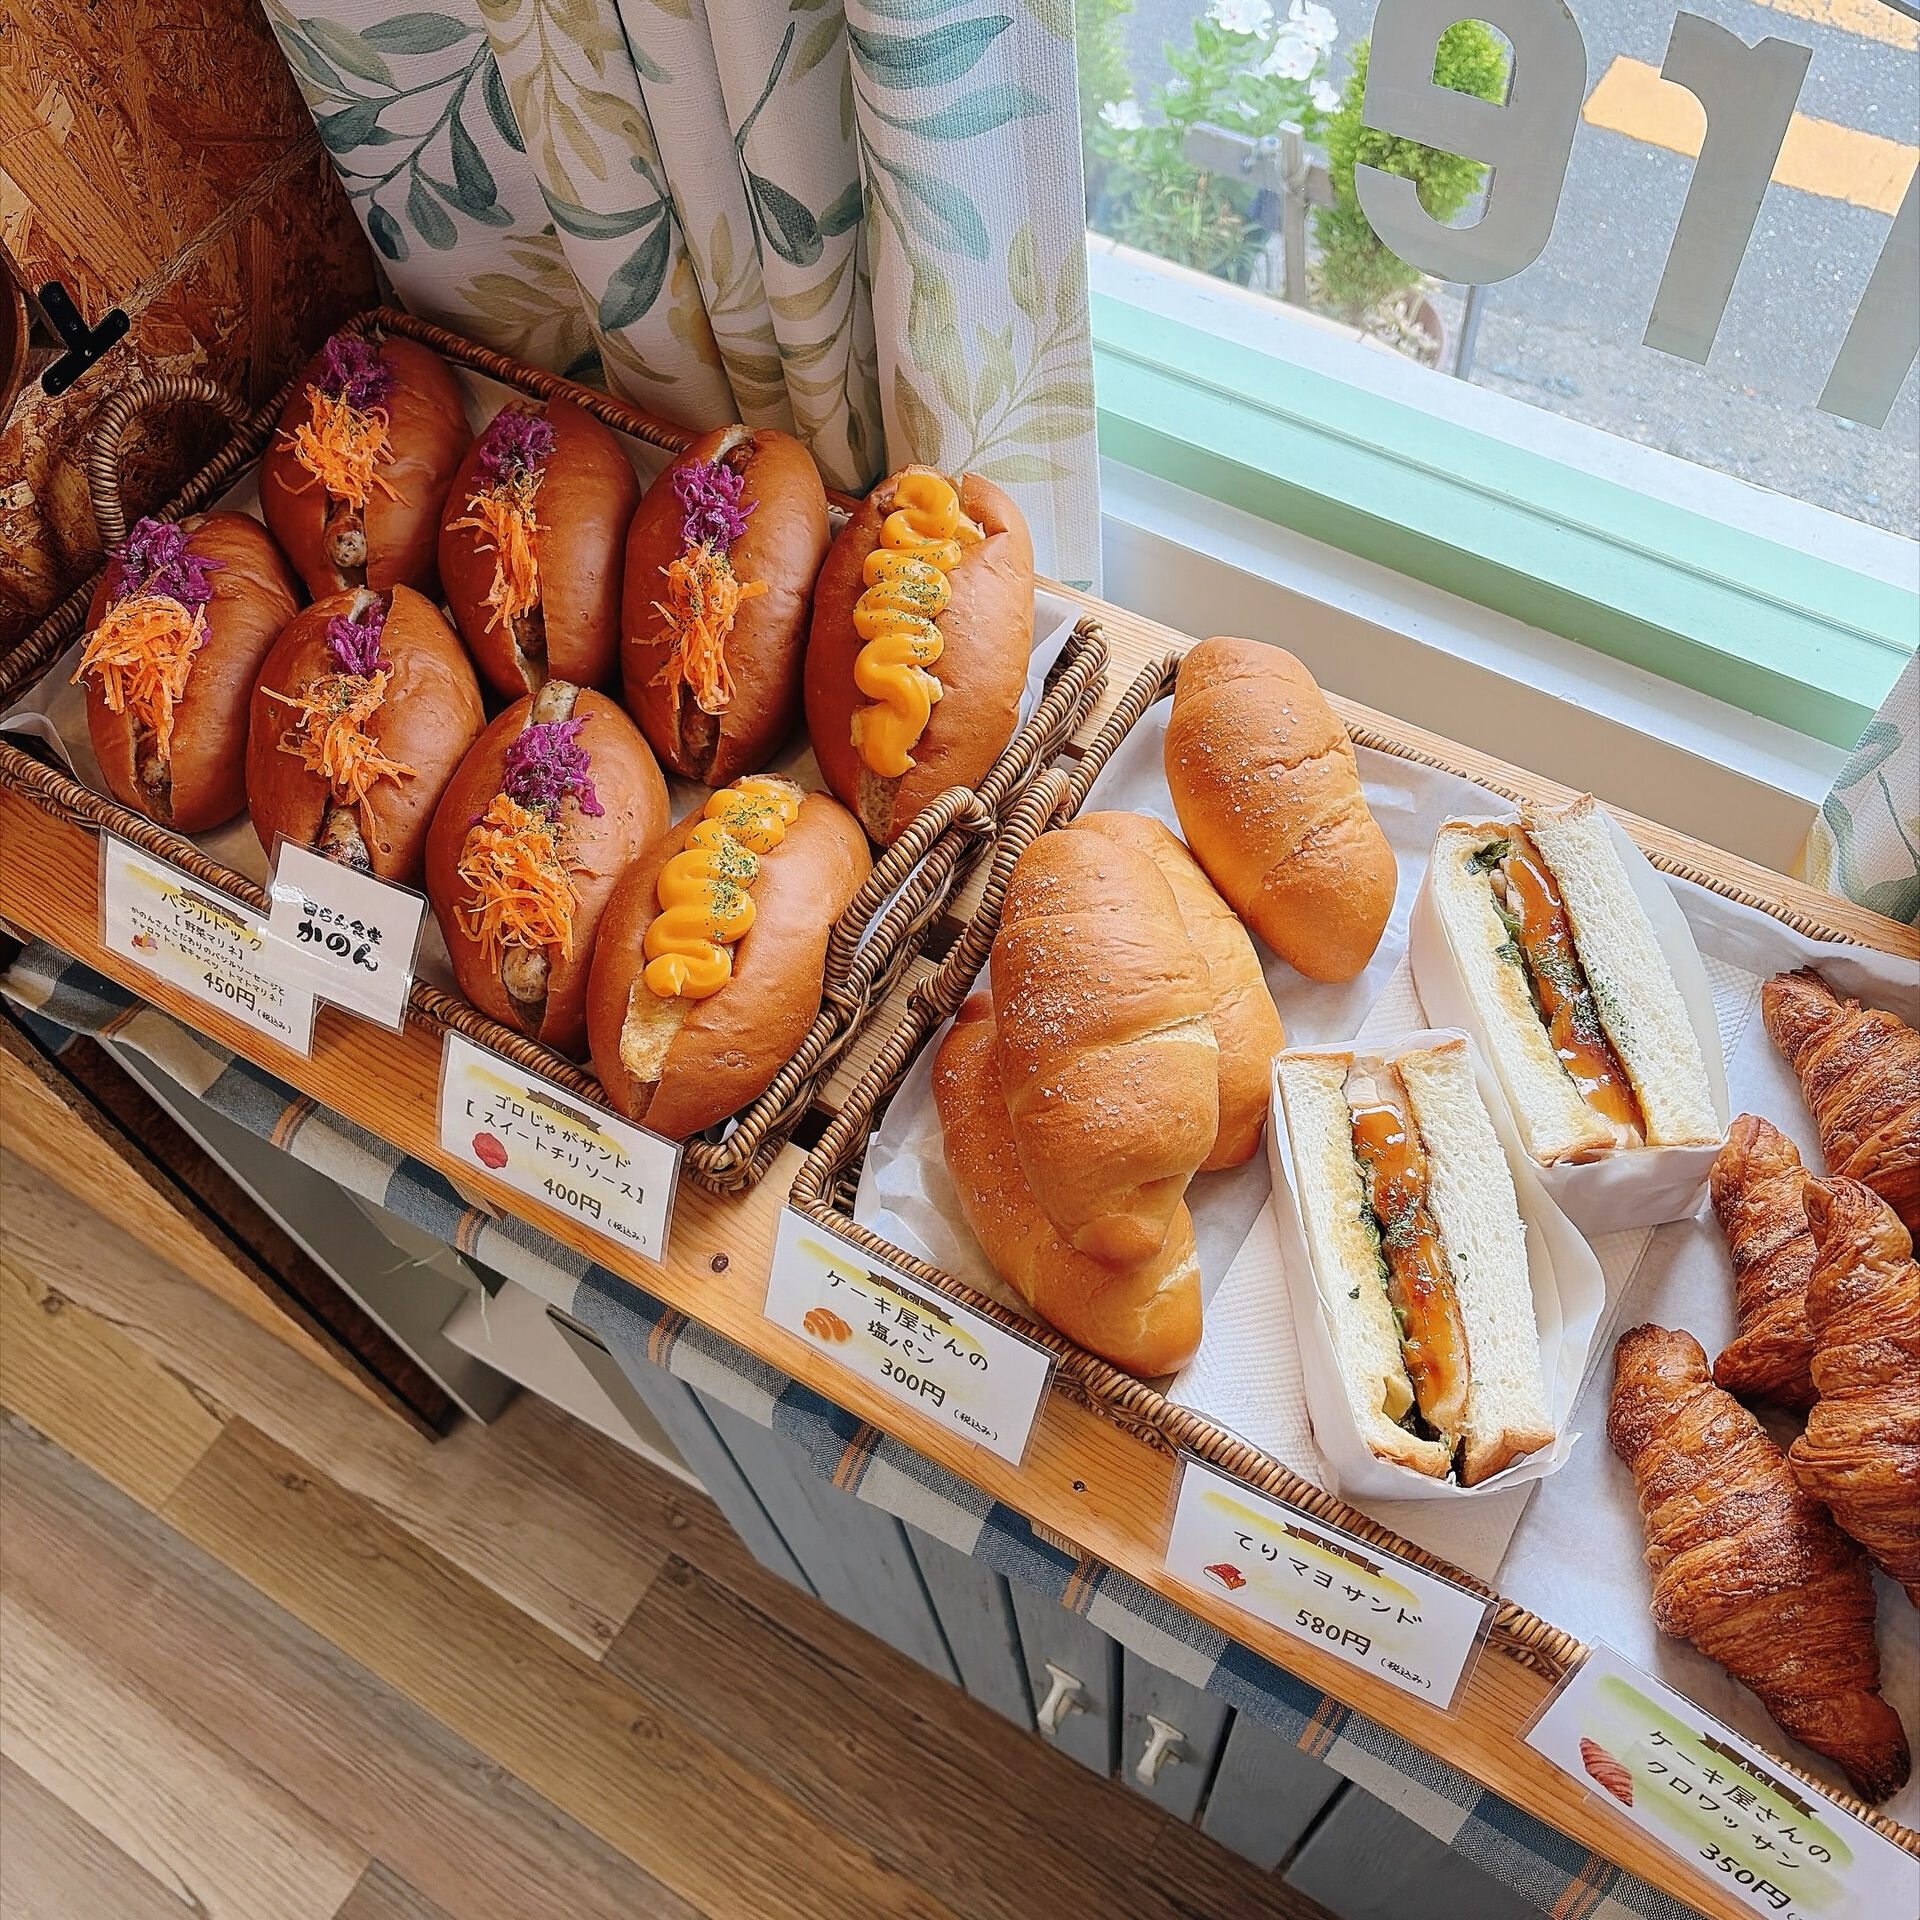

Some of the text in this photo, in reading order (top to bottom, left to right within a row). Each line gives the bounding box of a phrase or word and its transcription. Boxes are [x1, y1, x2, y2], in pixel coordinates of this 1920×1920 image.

[296, 919, 379, 972] かのん
[203, 972, 255, 1011] 450円
[495, 1093, 632, 1169] ゴロじゃがサンド
[543, 1177, 602, 1220] 400円
[826, 1269, 988, 1372] ケーキ屋さんの
[867, 1319, 935, 1365] 塩パン
[880, 1357, 946, 1408] 300円
[1233, 1529, 1423, 1626] てりマヨサンド
[1295, 1608, 1371, 1656] 580円
[1646, 1760, 1800, 1869] クロワッサン
[1649, 1729, 1832, 1864] ケーキ屋さんの
[1699, 1842, 1792, 1910] 350円
